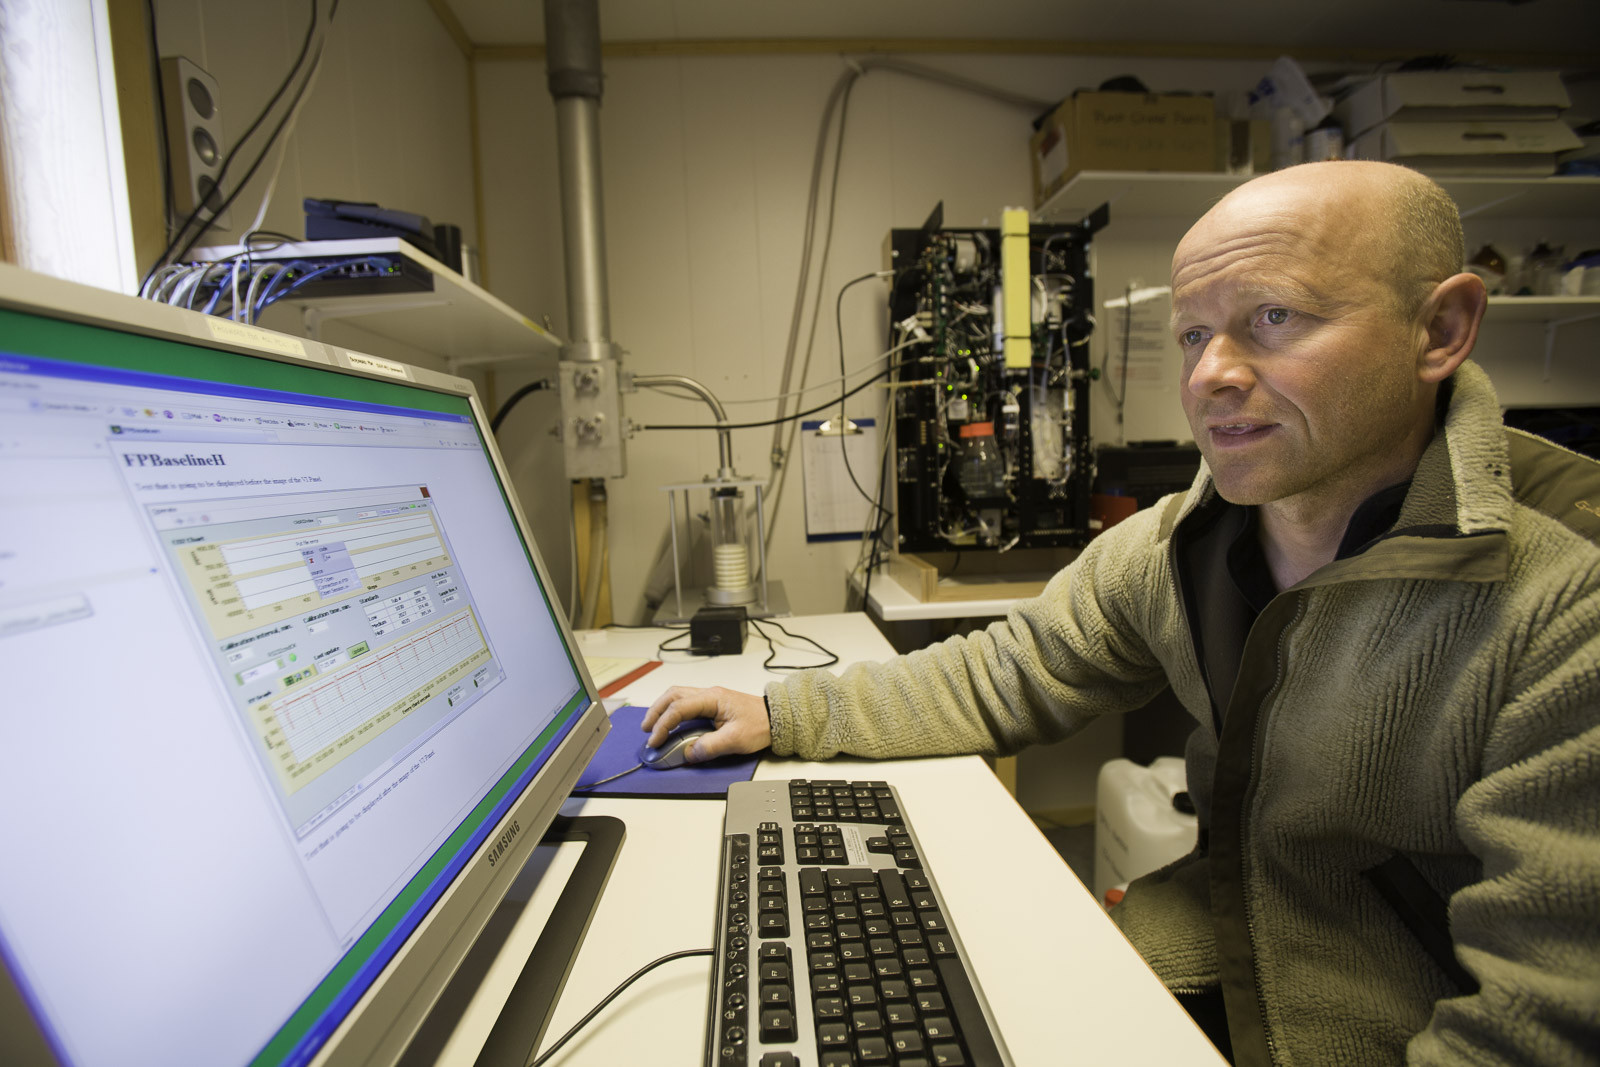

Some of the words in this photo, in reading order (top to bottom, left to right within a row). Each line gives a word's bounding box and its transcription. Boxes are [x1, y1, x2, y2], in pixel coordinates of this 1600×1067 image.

[122, 454, 226, 467] FPBaselineH
[216, 479, 244, 488] displayed
[488, 820, 520, 867] SAMSUNG
[773, 1018, 780, 1026] F5
[896, 1040, 906, 1048] G
